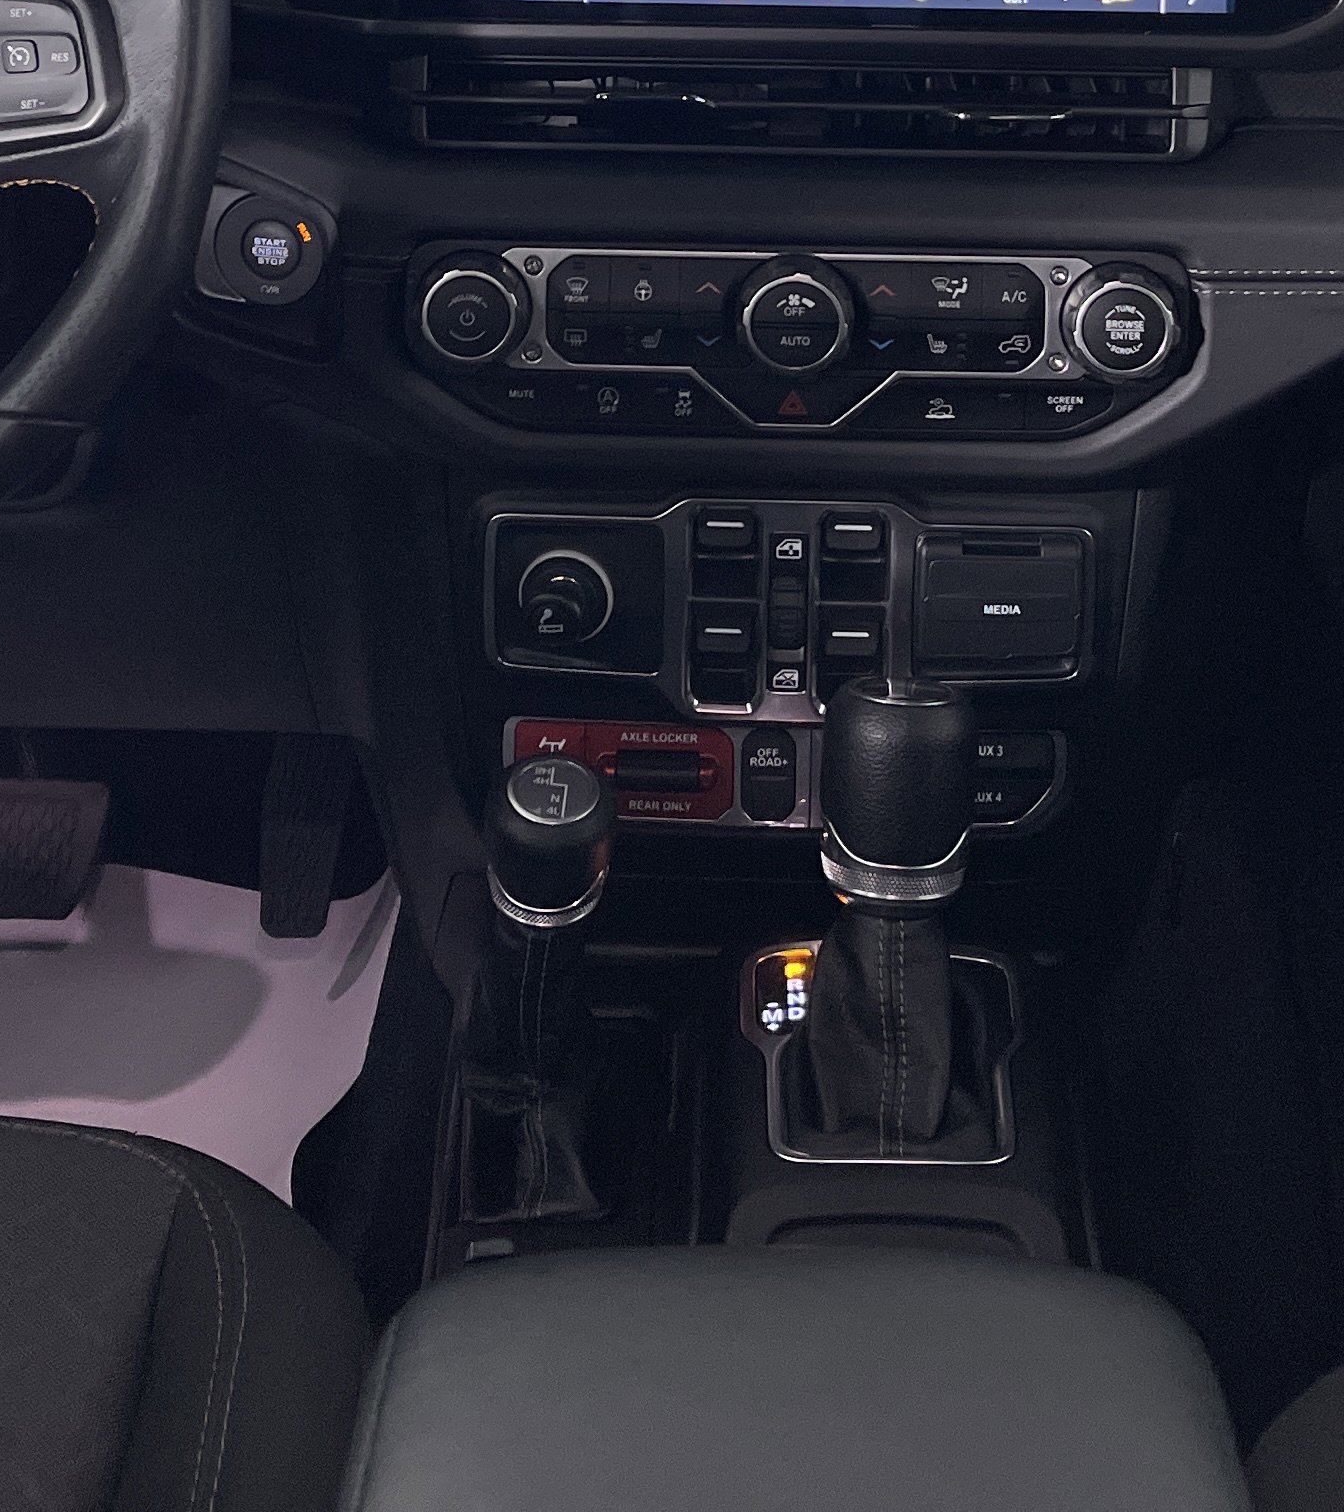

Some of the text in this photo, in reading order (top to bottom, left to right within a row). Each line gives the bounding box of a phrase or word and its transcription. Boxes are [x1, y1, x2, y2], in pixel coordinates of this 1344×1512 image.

[50, 52, 69, 64] RES
[253, 237, 287, 246] START
[257, 257, 286, 266] STOP
[1001, 290, 1027, 303] A/C
[783, 306, 805, 317] OFF
[1105, 319, 1144, 330] BROWSE
[780, 335, 811, 347] AUTO
[1110, 331, 1141, 340] ENTER
[508, 389, 535, 399] MUTE
[1047, 395, 1084, 404] SCREEN
[1055, 404, 1074, 413] OFF
[983, 603, 1021, 616] MEDIA
[620, 731, 698, 744] AXLE LOCKER
[756, 747, 780, 758] OFF
[978, 745, 993, 757] UX
[550, 794, 561, 803] N
[628, 799, 692, 812] REAR ONLY
[787, 979, 804, 992] R
[787, 992, 805, 1006] N
[762, 1008, 784, 1023] M
[788, 1006, 806, 1020] D
